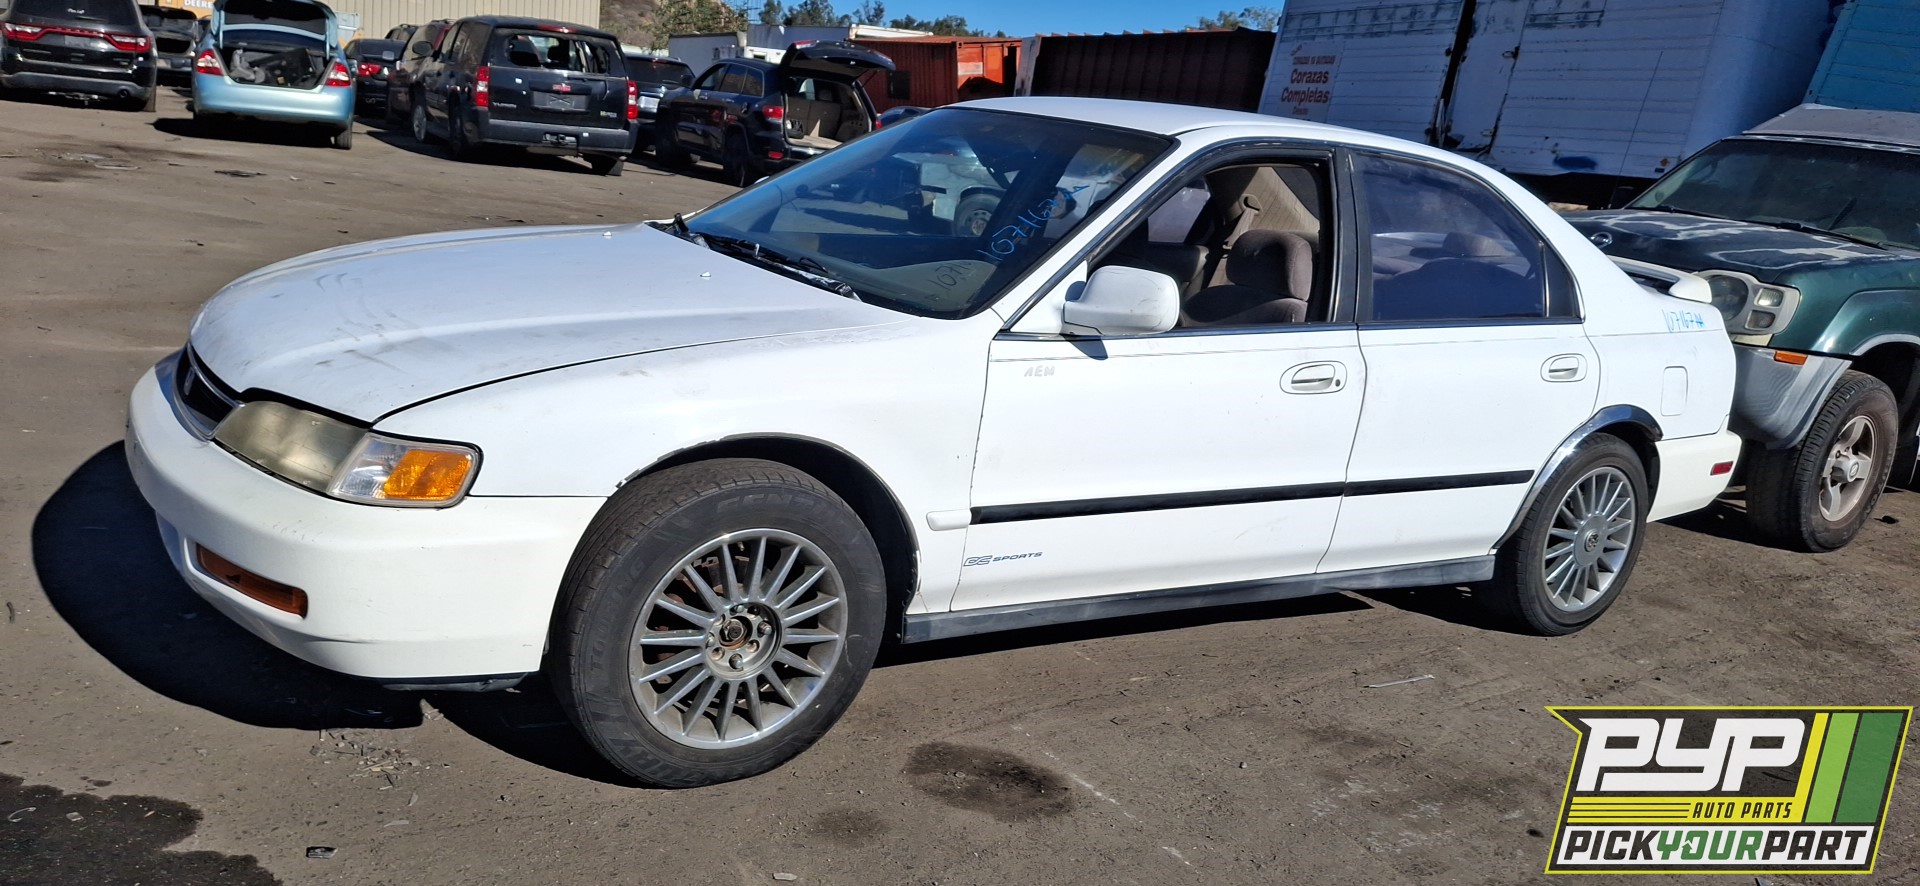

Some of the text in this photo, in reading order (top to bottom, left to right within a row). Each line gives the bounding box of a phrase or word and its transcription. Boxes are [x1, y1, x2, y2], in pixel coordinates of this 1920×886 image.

[1290, 68, 1329, 84] Corazas
[1281, 86, 1330, 106] Completas
[992, 552, 1044, 562] SPORTS
